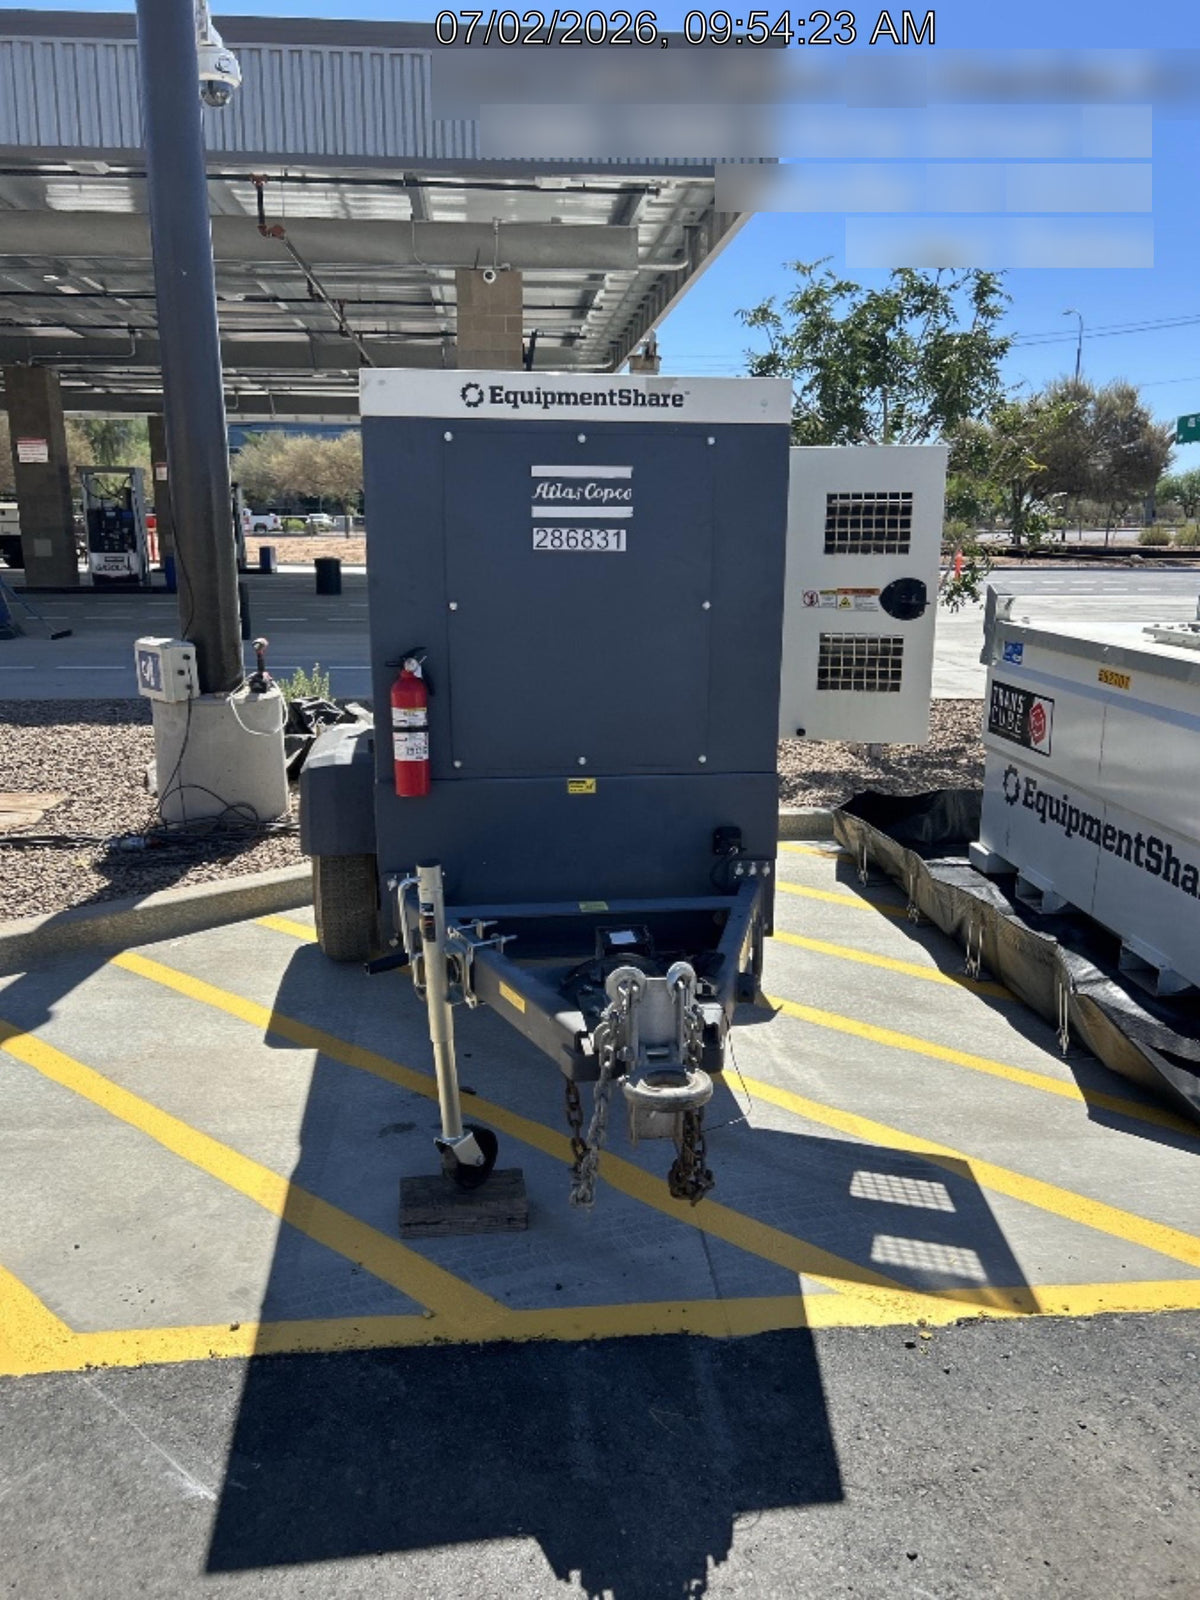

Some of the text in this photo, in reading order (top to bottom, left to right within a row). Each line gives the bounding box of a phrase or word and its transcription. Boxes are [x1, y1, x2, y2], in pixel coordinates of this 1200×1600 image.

[489, 385, 684, 409] EquipmentShare
[531, 482, 632, 504] Atlas Copco
[534, 528, 622, 550] 286831
[993, 685, 1027, 714] TRANS
[991, 705, 1022, 733] CUBE
[1022, 776, 1200, 900] EquipmentSha
